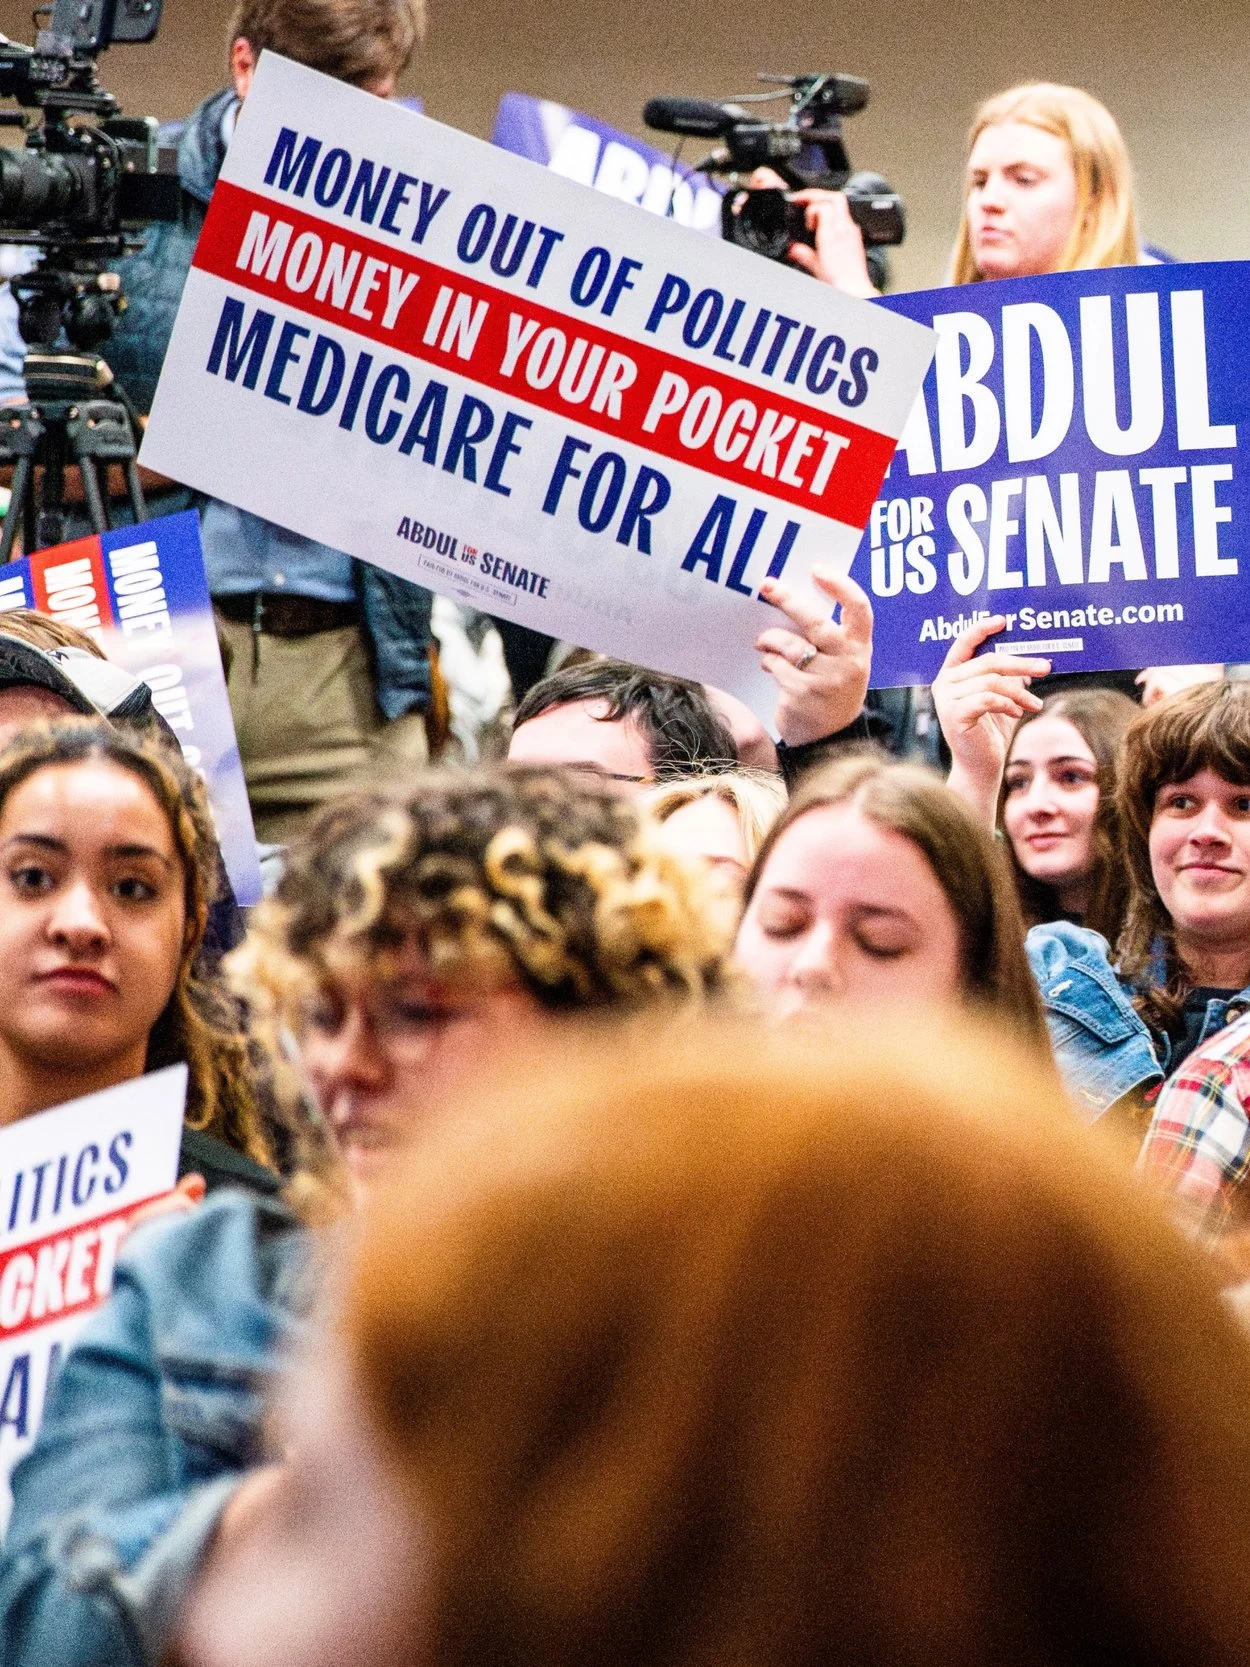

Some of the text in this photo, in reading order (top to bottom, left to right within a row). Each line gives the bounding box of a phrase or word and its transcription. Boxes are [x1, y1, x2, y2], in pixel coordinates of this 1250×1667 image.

[263, 126, 879, 408] MONEY OUT OF POLITICS
[235, 210, 852, 497] MONEY IN YOUR POCKET
[206, 295, 801, 602] MEDICARE FOR ALL
[396, 516, 458, 561] ABDUL
[480, 552, 550, 599] SENATE
[870, 464, 1239, 597] FOR SENATE
[870, 535, 938, 597] US
[918, 602, 1185, 642] AbdlrSenate.com
